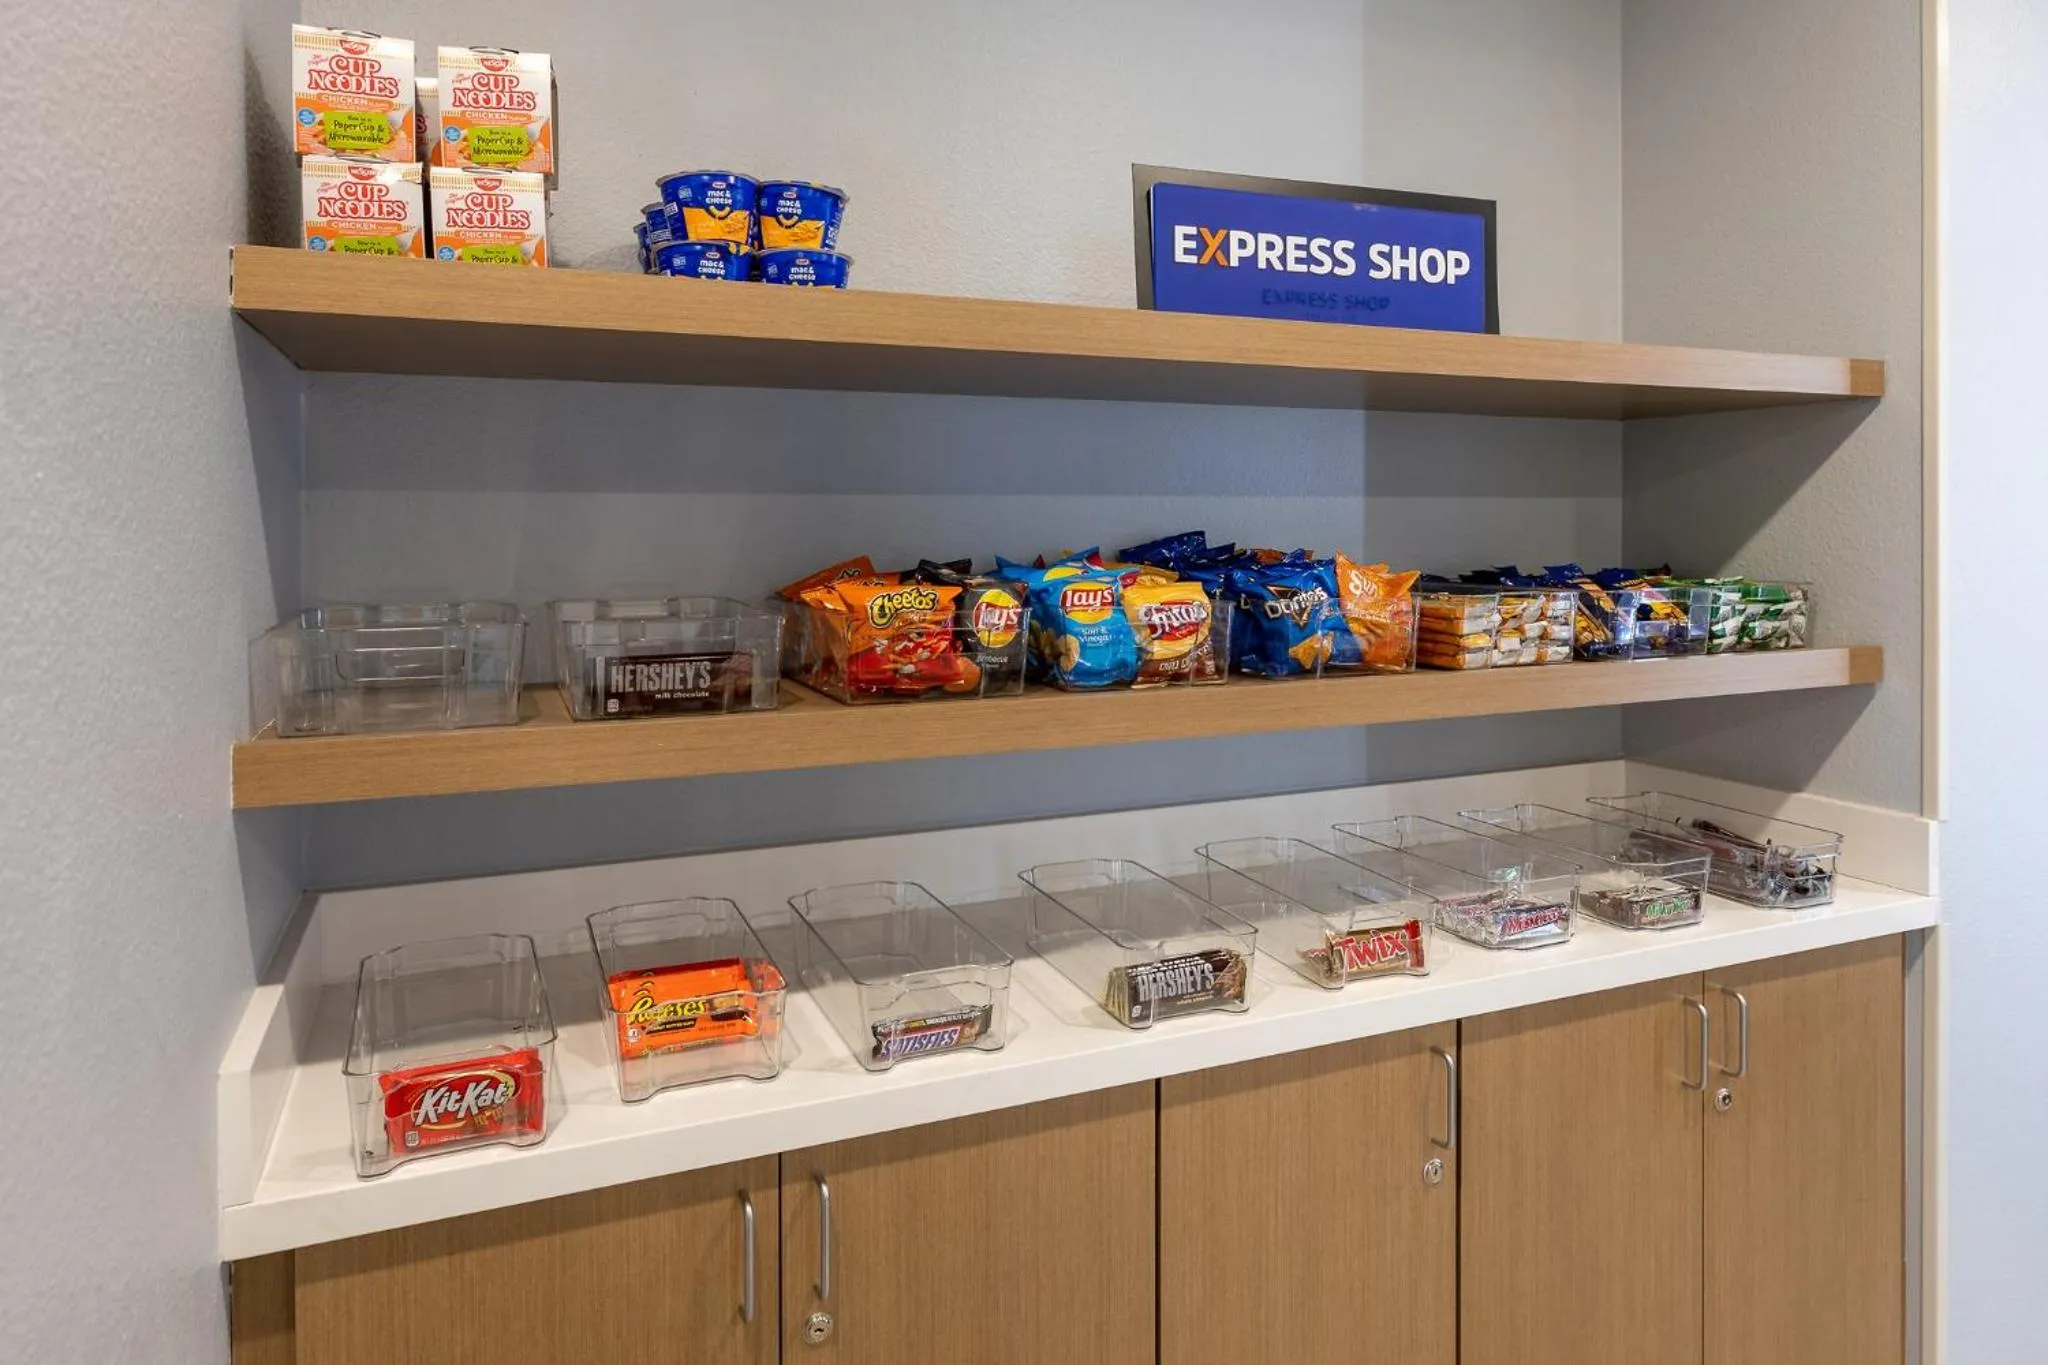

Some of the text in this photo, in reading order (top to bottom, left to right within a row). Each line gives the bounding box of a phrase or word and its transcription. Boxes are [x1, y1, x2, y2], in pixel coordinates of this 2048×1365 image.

[329, 55, 382, 77] CUP
[308, 69, 400, 98] NOODLES
[472, 72, 520, 92] CUP
[322, 95, 369, 106] CHICKEN
[453, 88, 536, 111] NOODLES
[465, 111, 508, 120] CHICKEN
[338, 181, 390, 201] CUP
[465, 192, 513, 211] CUP
[318, 197, 407, 221] NOODLES
[446, 208, 531, 230] NOODLES
[332, 220, 376, 230] CHICKEN
[1173, 224, 1470, 285] EXPRESS SHOP
[869, 586, 938, 628] Cheetos
[1264, 587, 1329, 619] Doritos
[610, 661, 711, 693] HERSHEY'S
[655, 691, 710, 700] milk chocolate
[1137, 963, 1215, 1002] HERSHEY'S
[881, 1028, 959, 1058] SATISFIES
